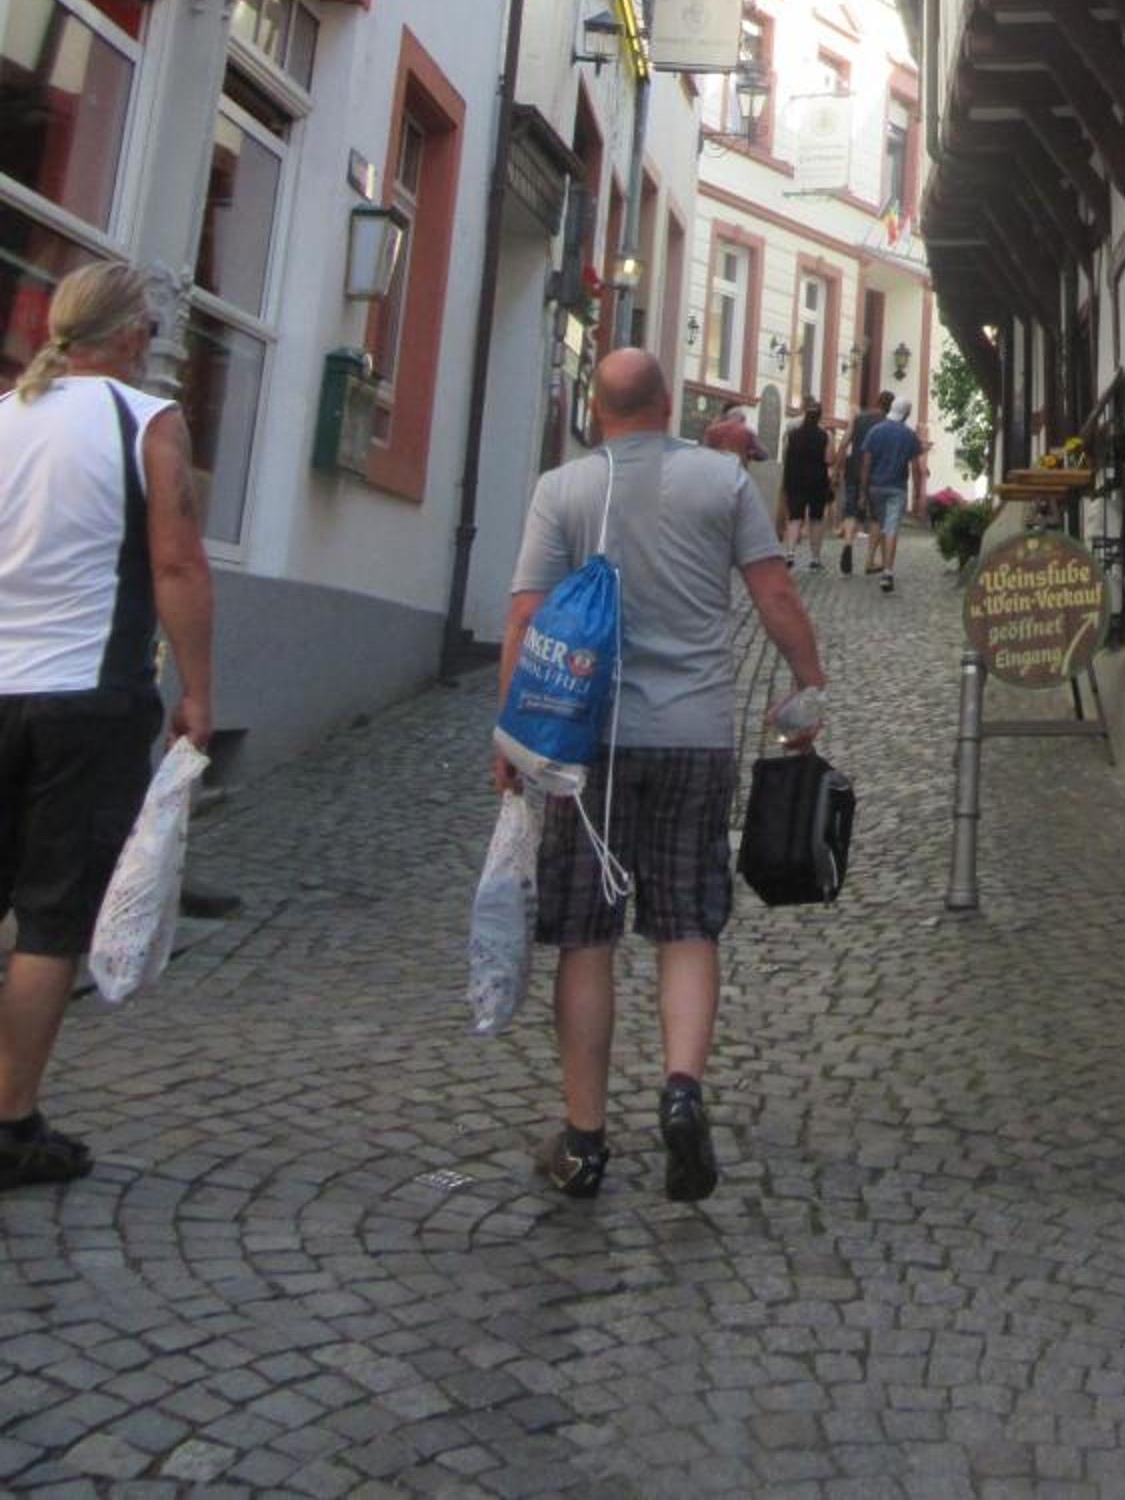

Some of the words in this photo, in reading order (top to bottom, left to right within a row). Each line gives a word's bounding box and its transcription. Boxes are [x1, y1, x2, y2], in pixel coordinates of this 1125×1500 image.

[979, 557, 1090, 593] Weinstube
[989, 613, 1066, 646] geöffnet
[995, 647, 1064, 675] Eingang
